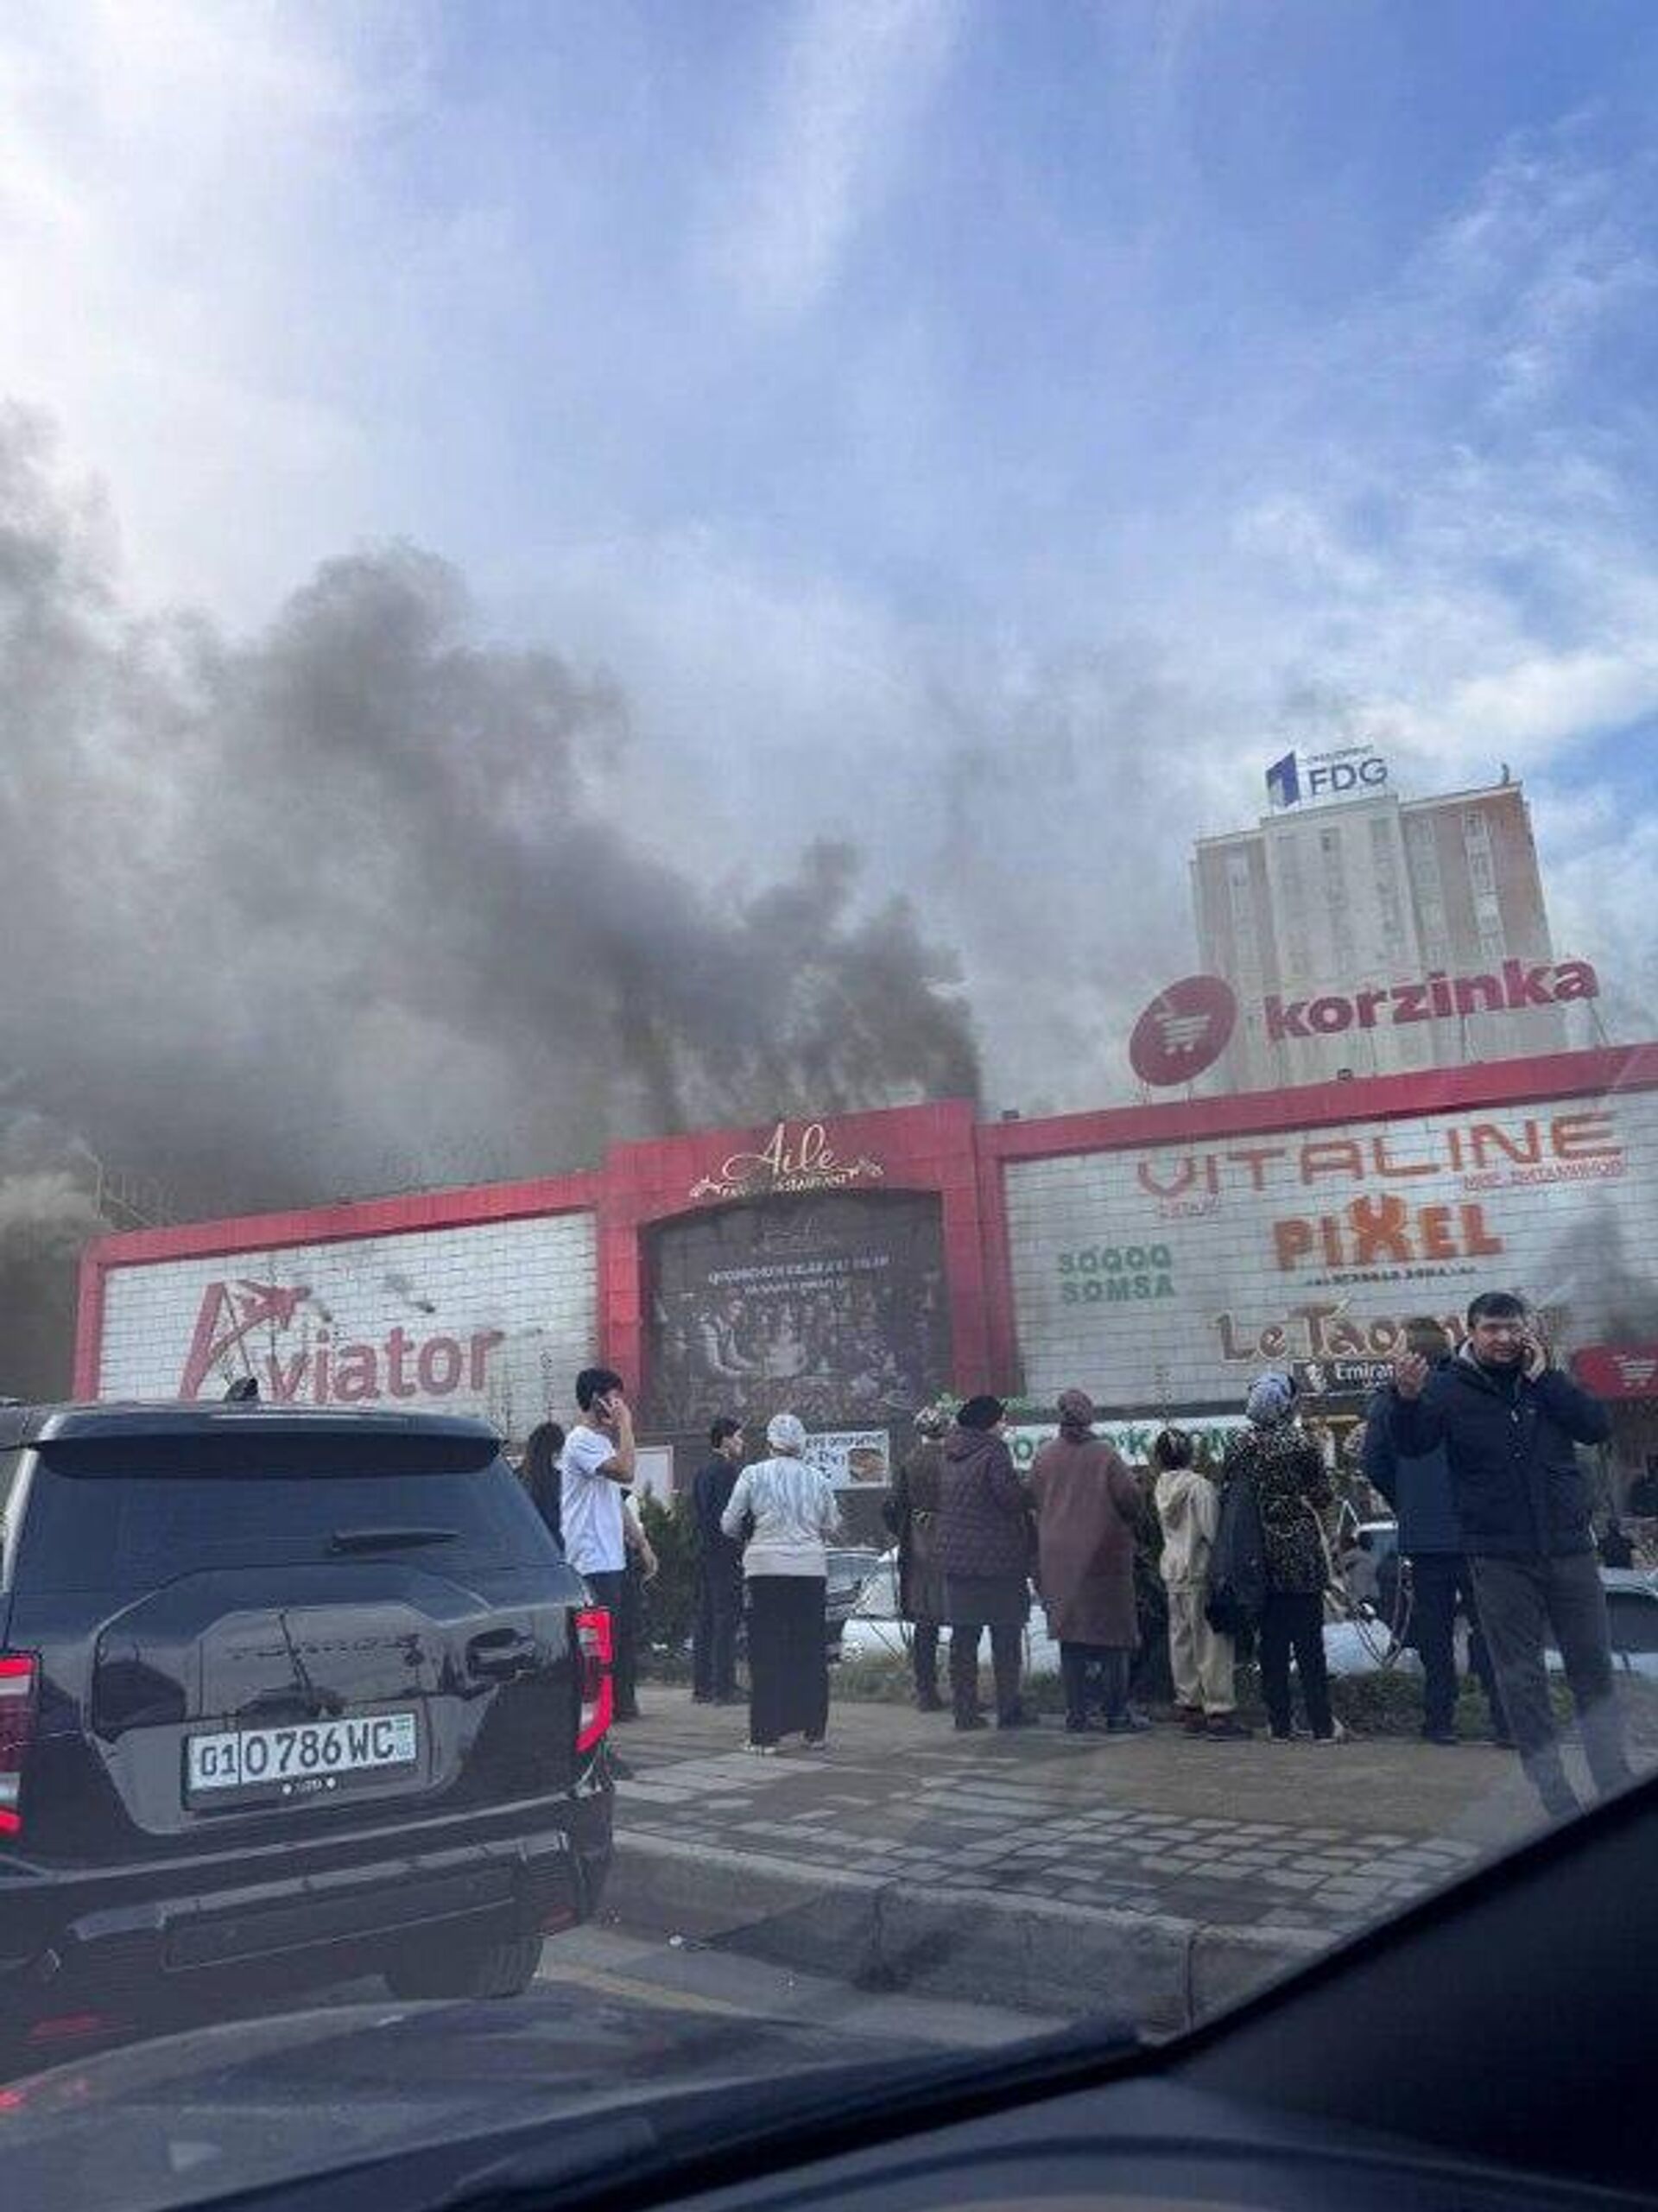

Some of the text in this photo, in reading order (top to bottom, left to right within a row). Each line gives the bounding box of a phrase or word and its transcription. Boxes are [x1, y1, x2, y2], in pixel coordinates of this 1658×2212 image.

[1307, 757, 1389, 795] FDG
[1263, 957, 1601, 1040] korzinka
[722, 1122, 844, 1181] Aile
[1136, 1113, 1623, 1197] VITALINE
[1273, 1194, 1504, 1272] PIXEL
[177, 1280, 506, 1404] Aviator
[1218, 1310, 1288, 1361] Le
